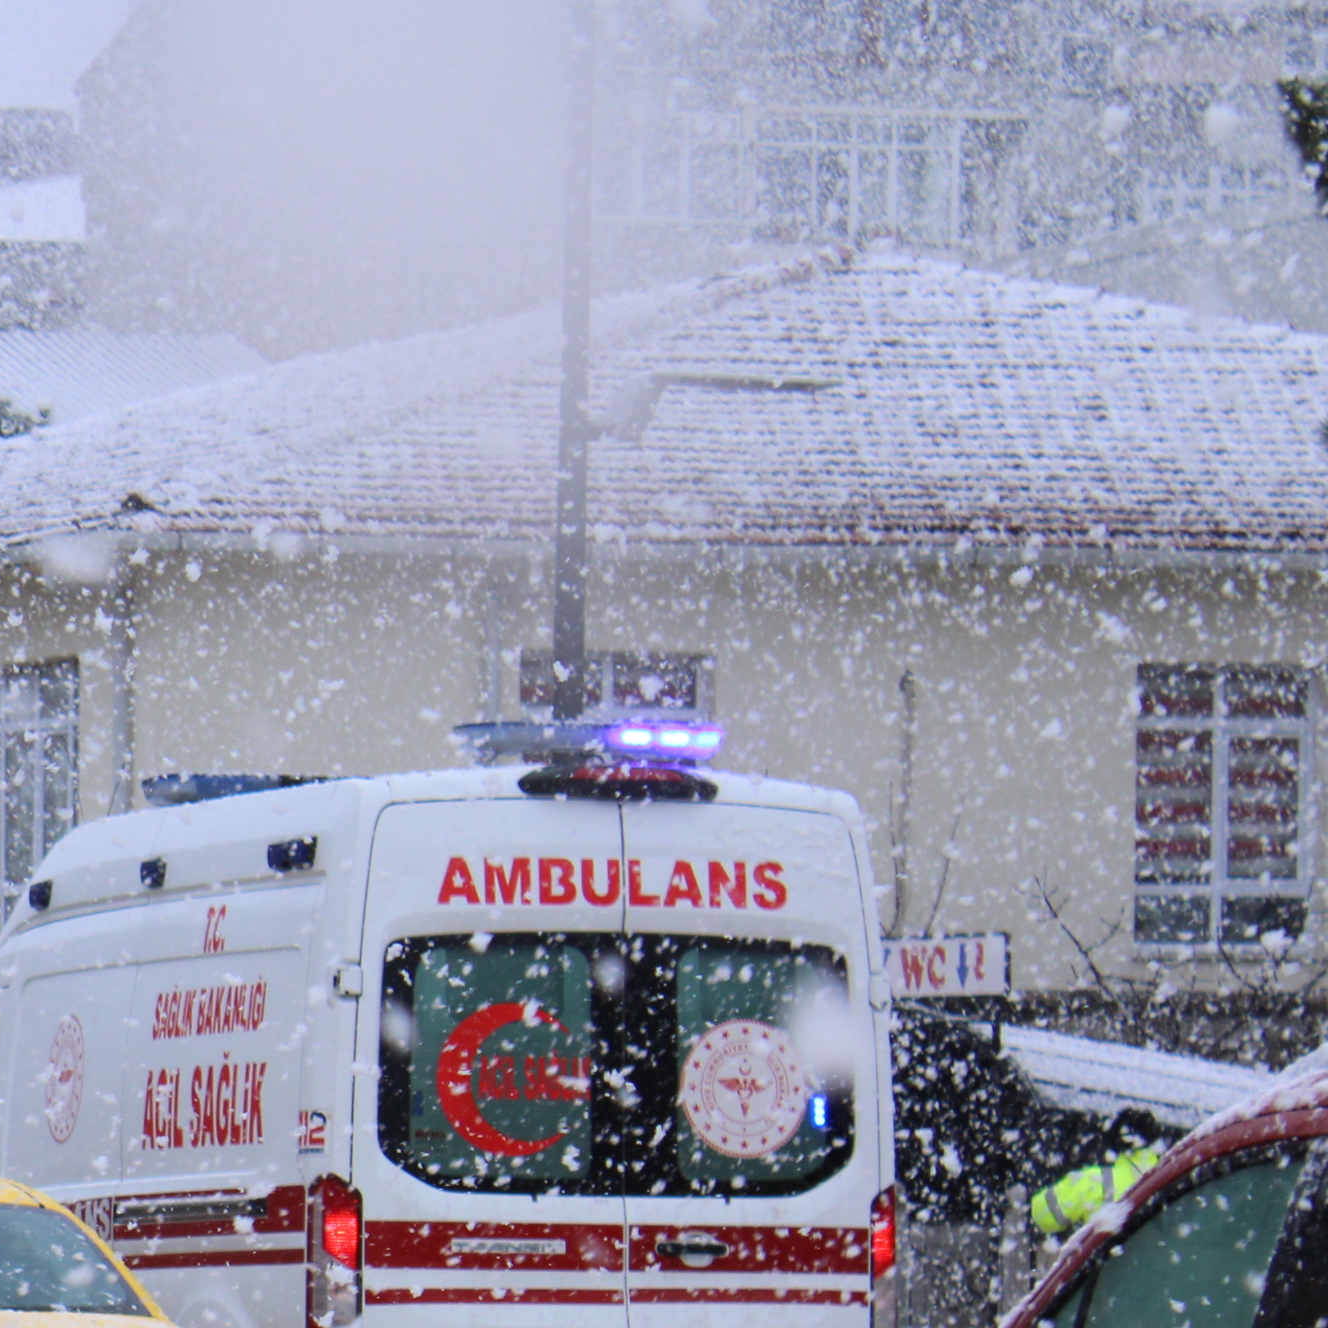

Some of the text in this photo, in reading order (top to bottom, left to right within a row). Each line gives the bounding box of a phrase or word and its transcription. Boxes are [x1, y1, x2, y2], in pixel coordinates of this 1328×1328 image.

[438, 856, 788, 910] AMBULANS
[203, 904, 226, 952] T.C.
[900, 946, 946, 990] WC
